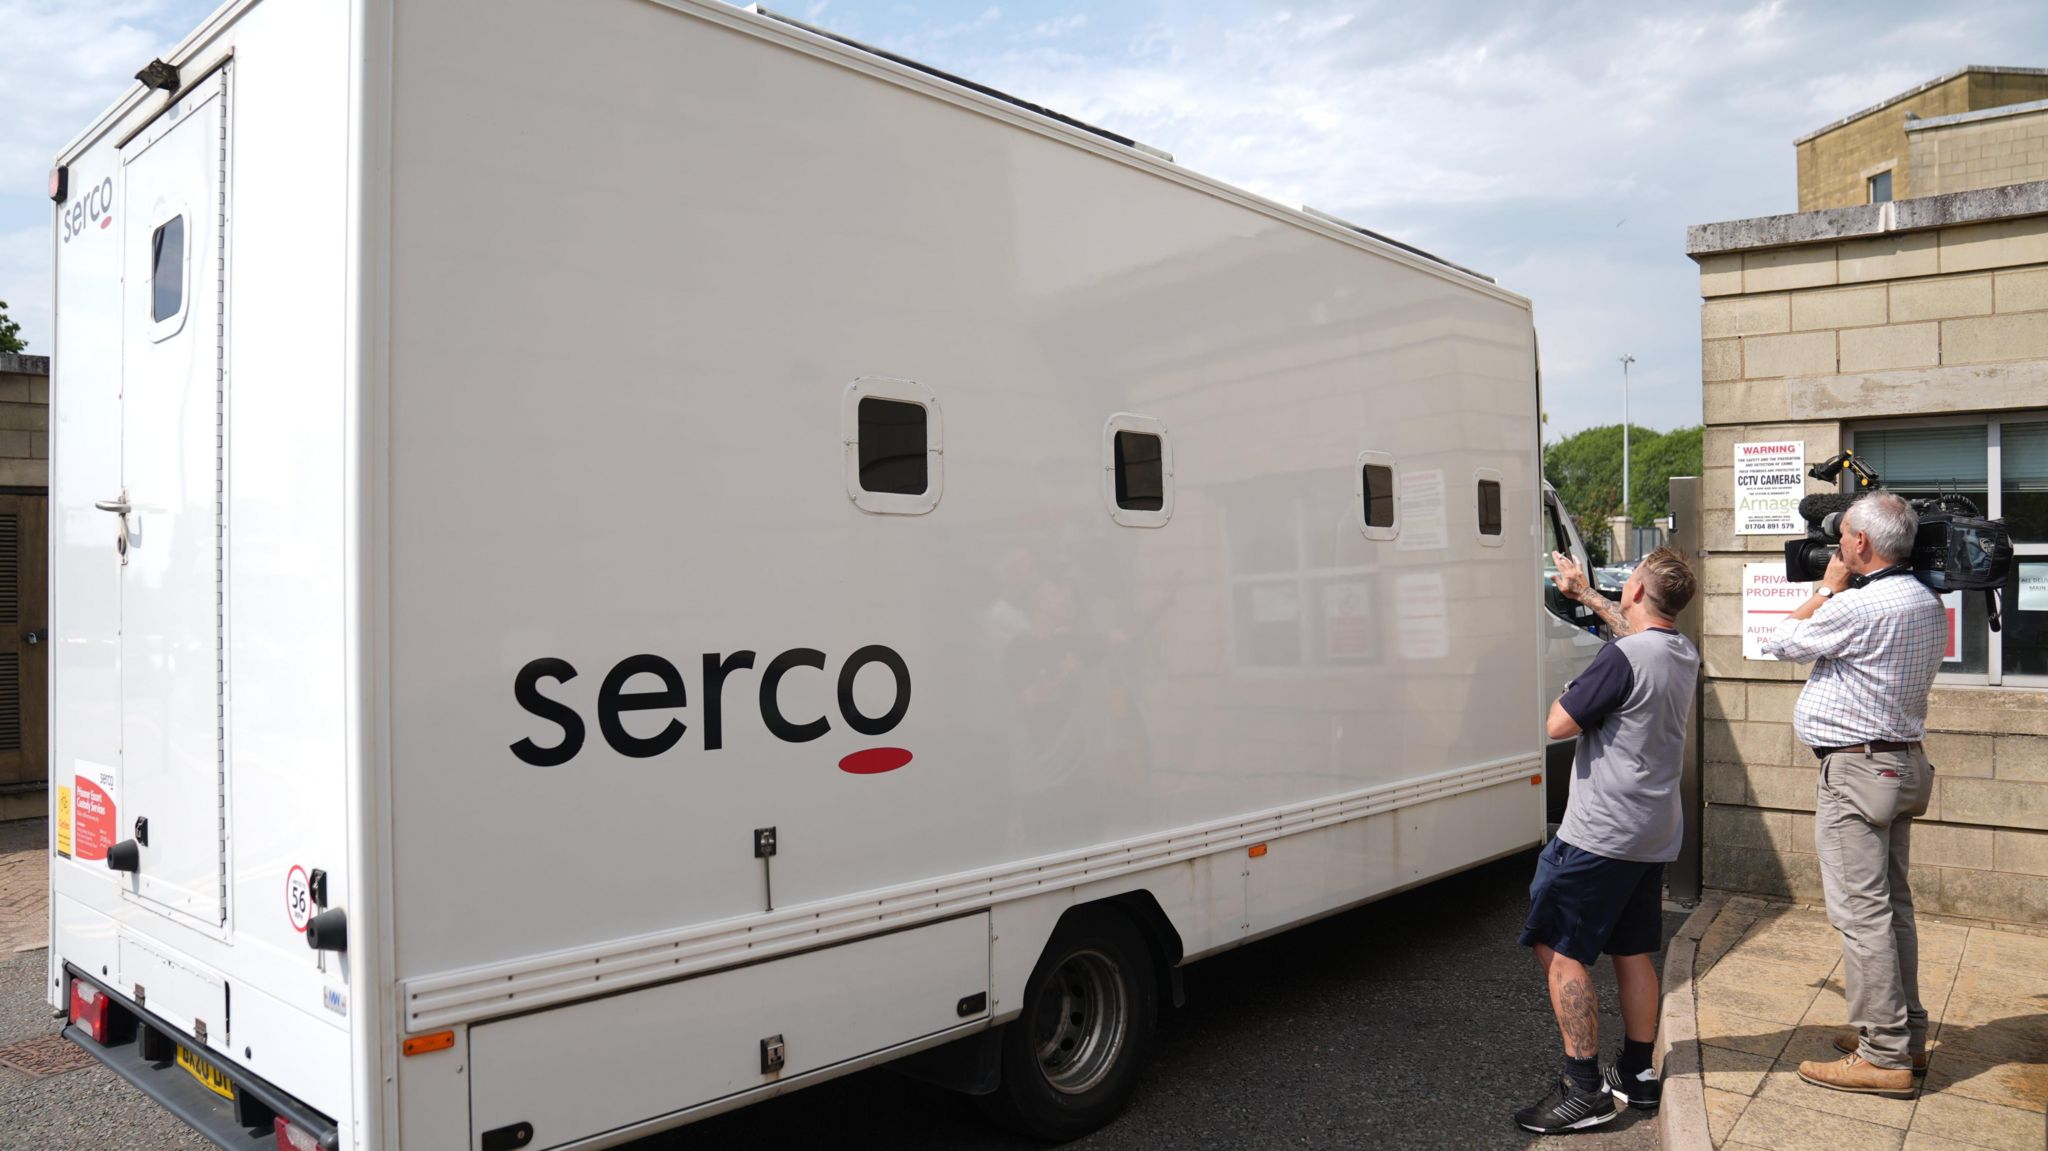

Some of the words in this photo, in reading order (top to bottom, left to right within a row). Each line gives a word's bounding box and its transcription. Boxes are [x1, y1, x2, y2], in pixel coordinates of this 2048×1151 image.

[64, 176, 112, 243] serco
[1743, 445, 1796, 454] WARNING
[1738, 475, 1758, 486] CCTV
[1760, 474, 1801, 485] CAMERAS
[1746, 588, 1808, 597] PROPERTY
[509, 644, 912, 767] serco
[292, 886, 306, 913] 56
